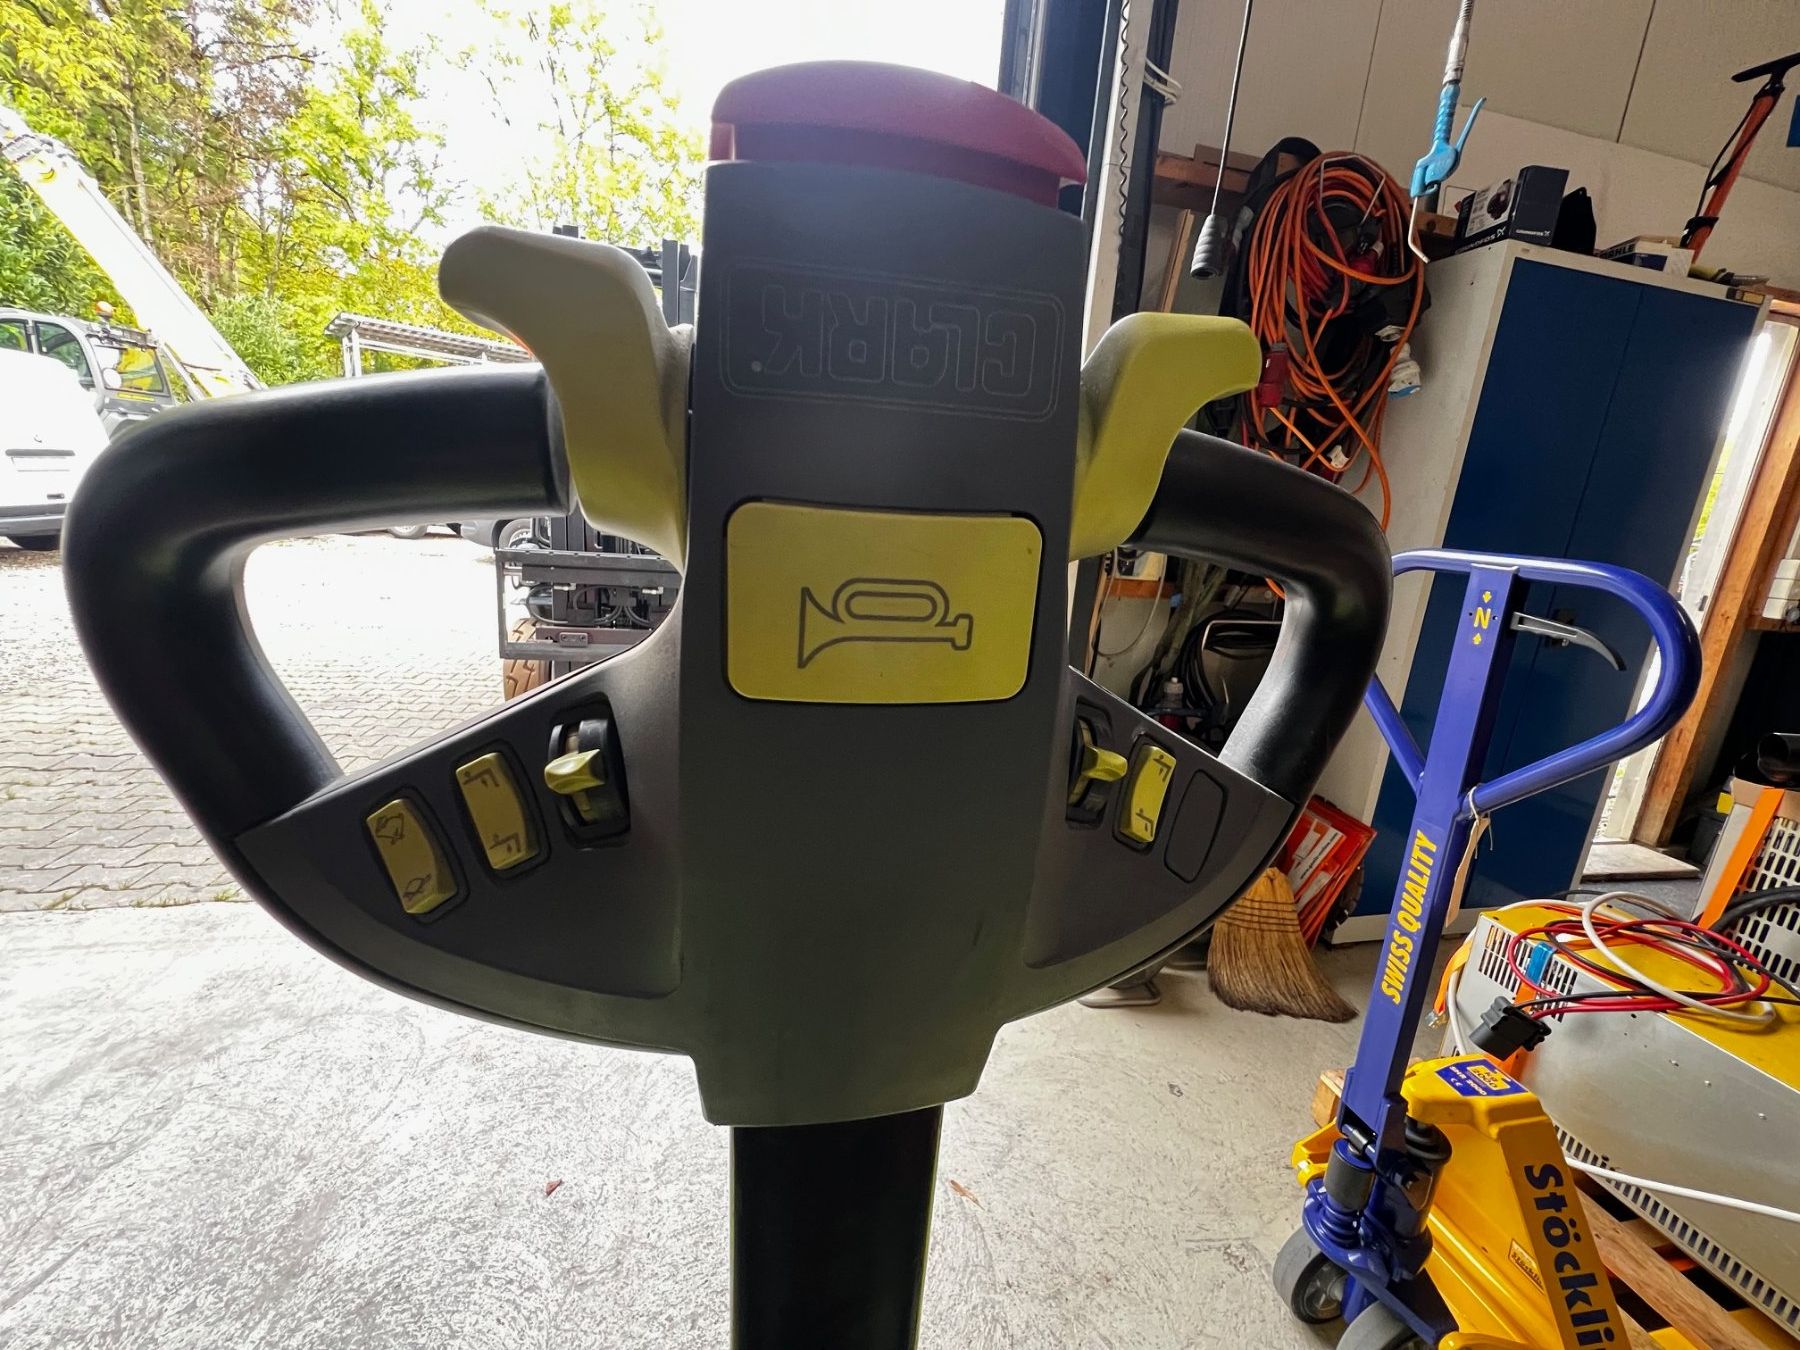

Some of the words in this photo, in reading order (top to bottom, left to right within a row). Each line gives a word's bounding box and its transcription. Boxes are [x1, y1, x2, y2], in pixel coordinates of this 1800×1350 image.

[761, 285, 1038, 397] CLARK
[1474, 607, 1492, 629] N
[1397, 829, 1437, 932] QUALITY
[1381, 930, 1414, 1006] SWISS
[1524, 1163, 1615, 1350] Stöckli
